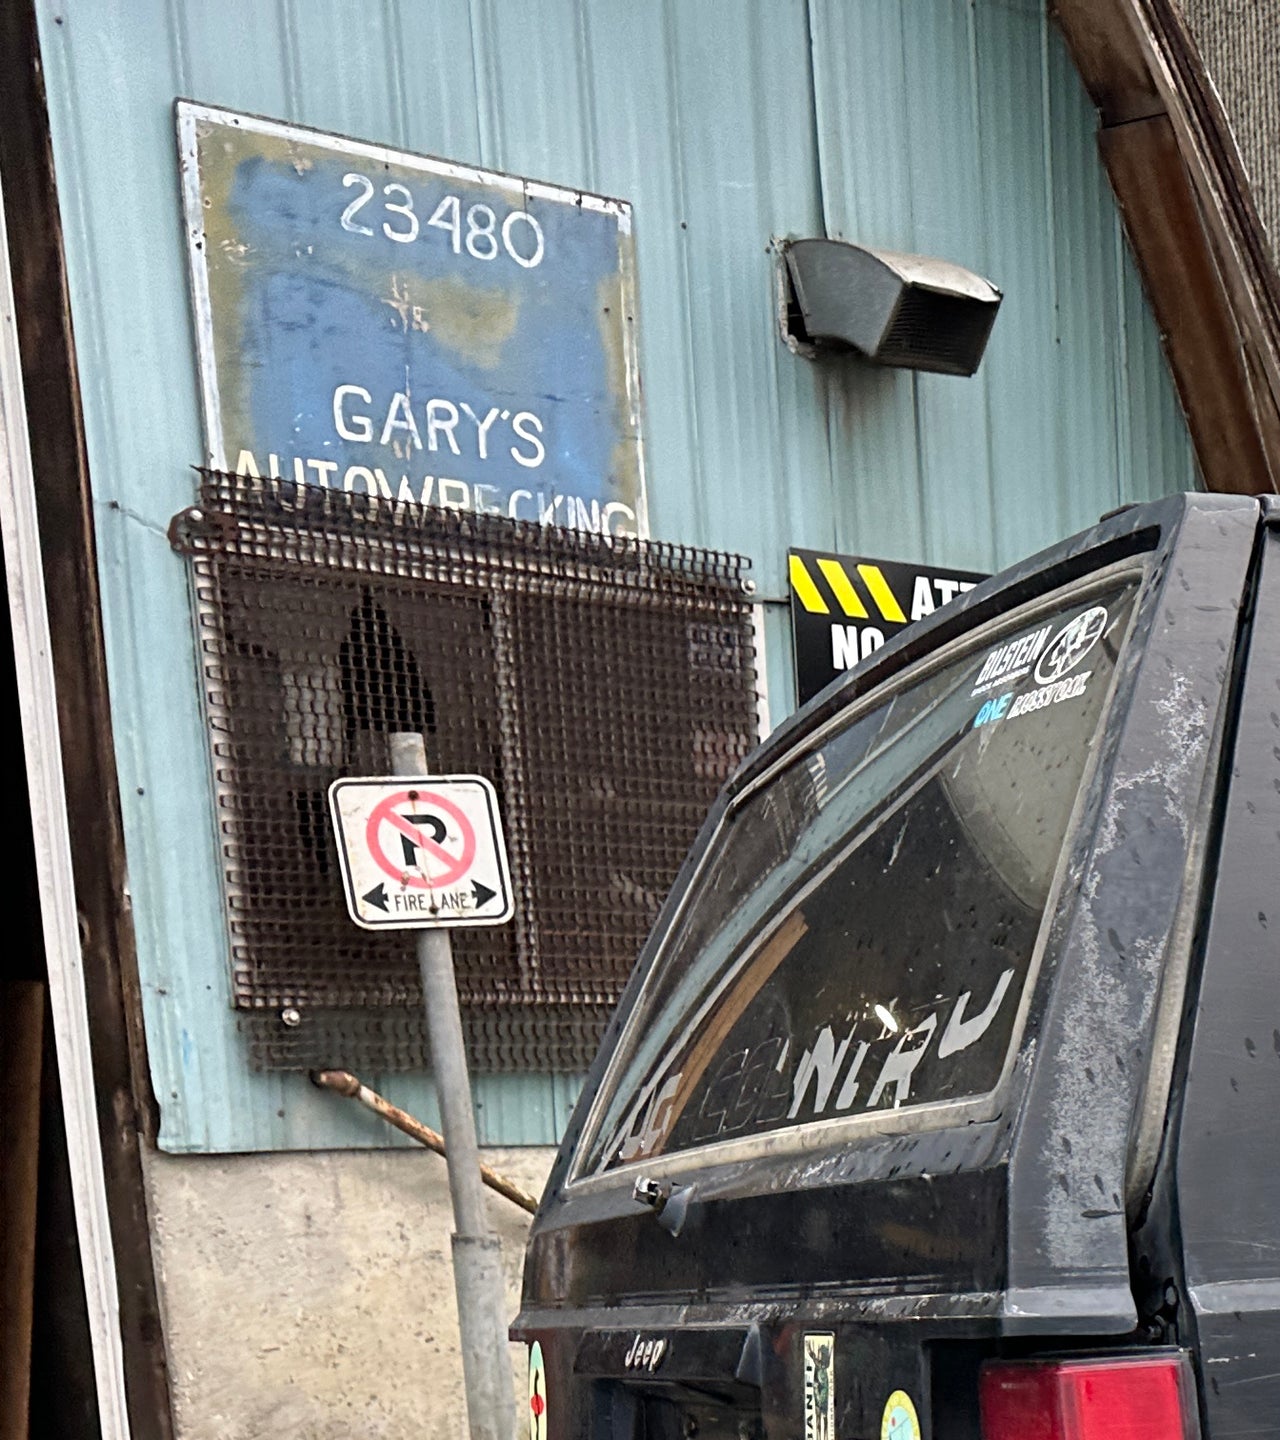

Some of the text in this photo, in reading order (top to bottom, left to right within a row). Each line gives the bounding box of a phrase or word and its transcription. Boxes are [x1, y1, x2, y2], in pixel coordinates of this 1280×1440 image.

[340, 172, 544, 268] 23480
[333, 384, 545, 468] GARY'S
[394, 893, 427, 912] FIRE
[625, 1334, 666, 1373] Jeep
